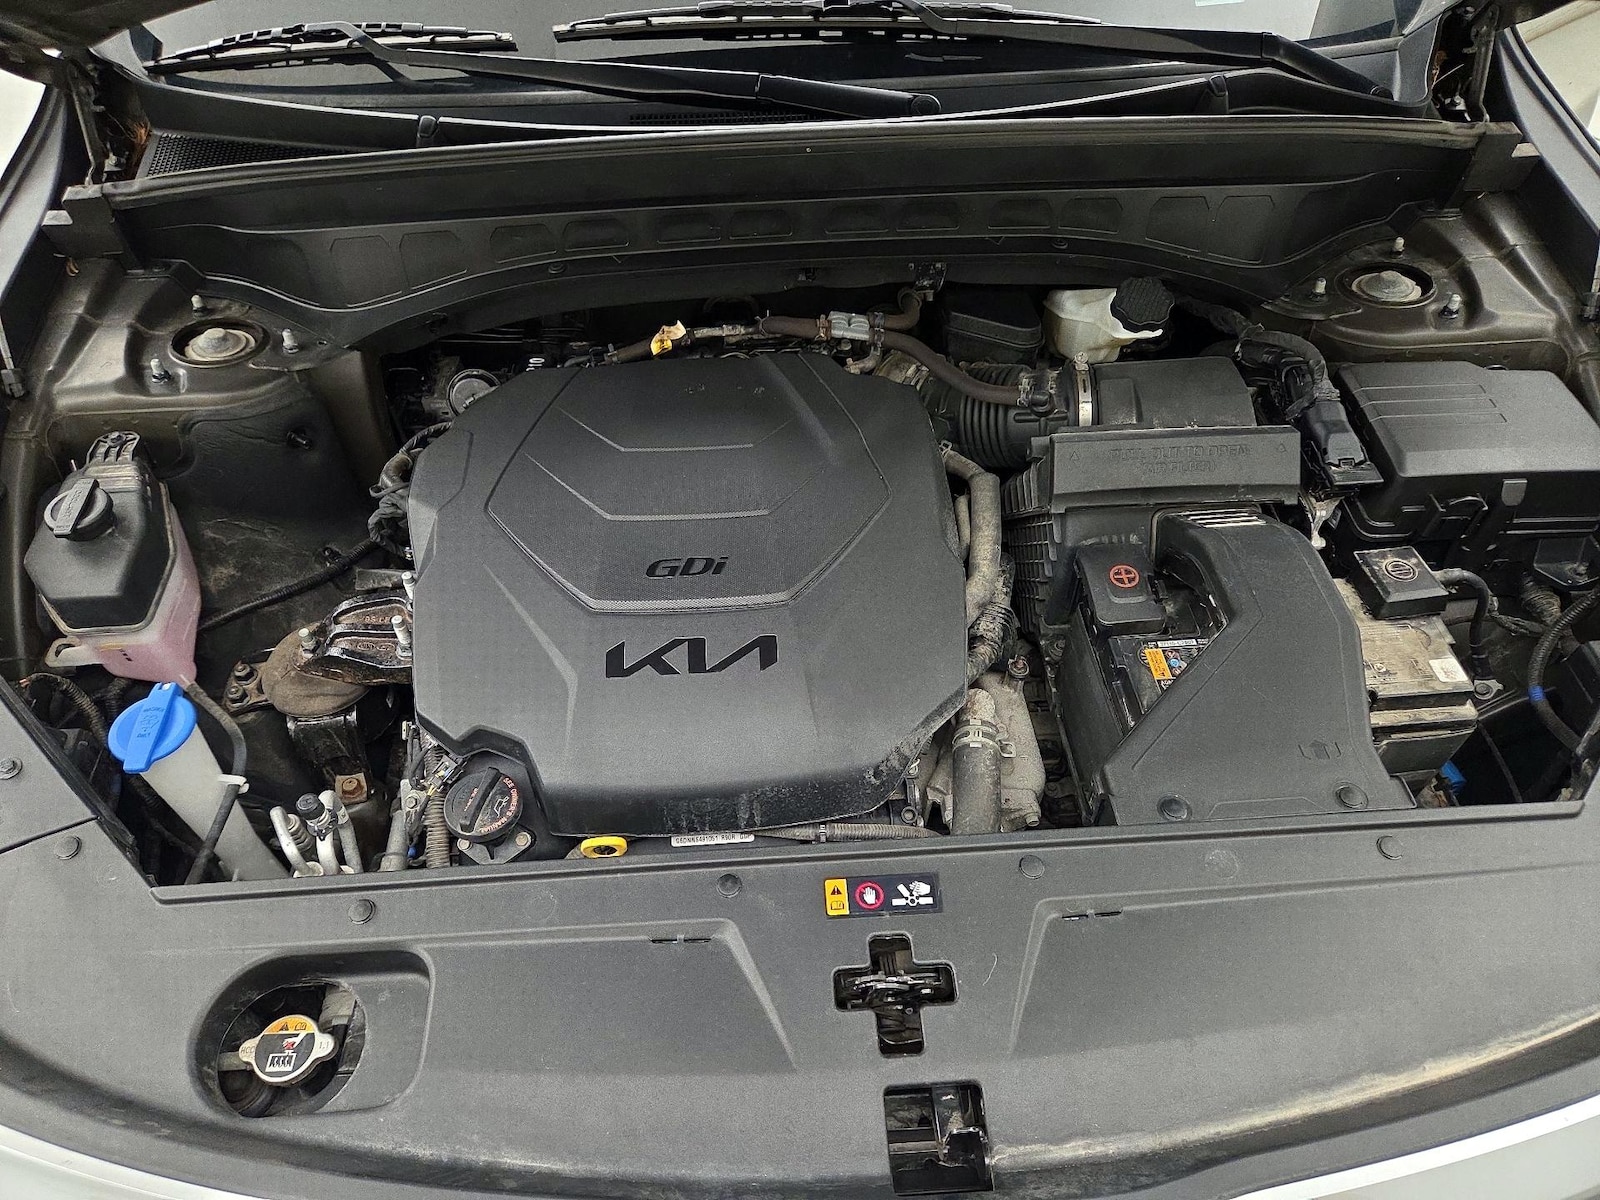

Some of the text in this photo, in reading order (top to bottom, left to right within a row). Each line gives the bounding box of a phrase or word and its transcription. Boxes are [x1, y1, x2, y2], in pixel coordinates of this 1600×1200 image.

[1185, 445, 1204, 458] TO
[1208, 444, 1251, 457] OPEN
[646, 557, 728, 577] GDi
[606, 634, 777, 678] KIA
[503, 777, 515, 788] SEE
